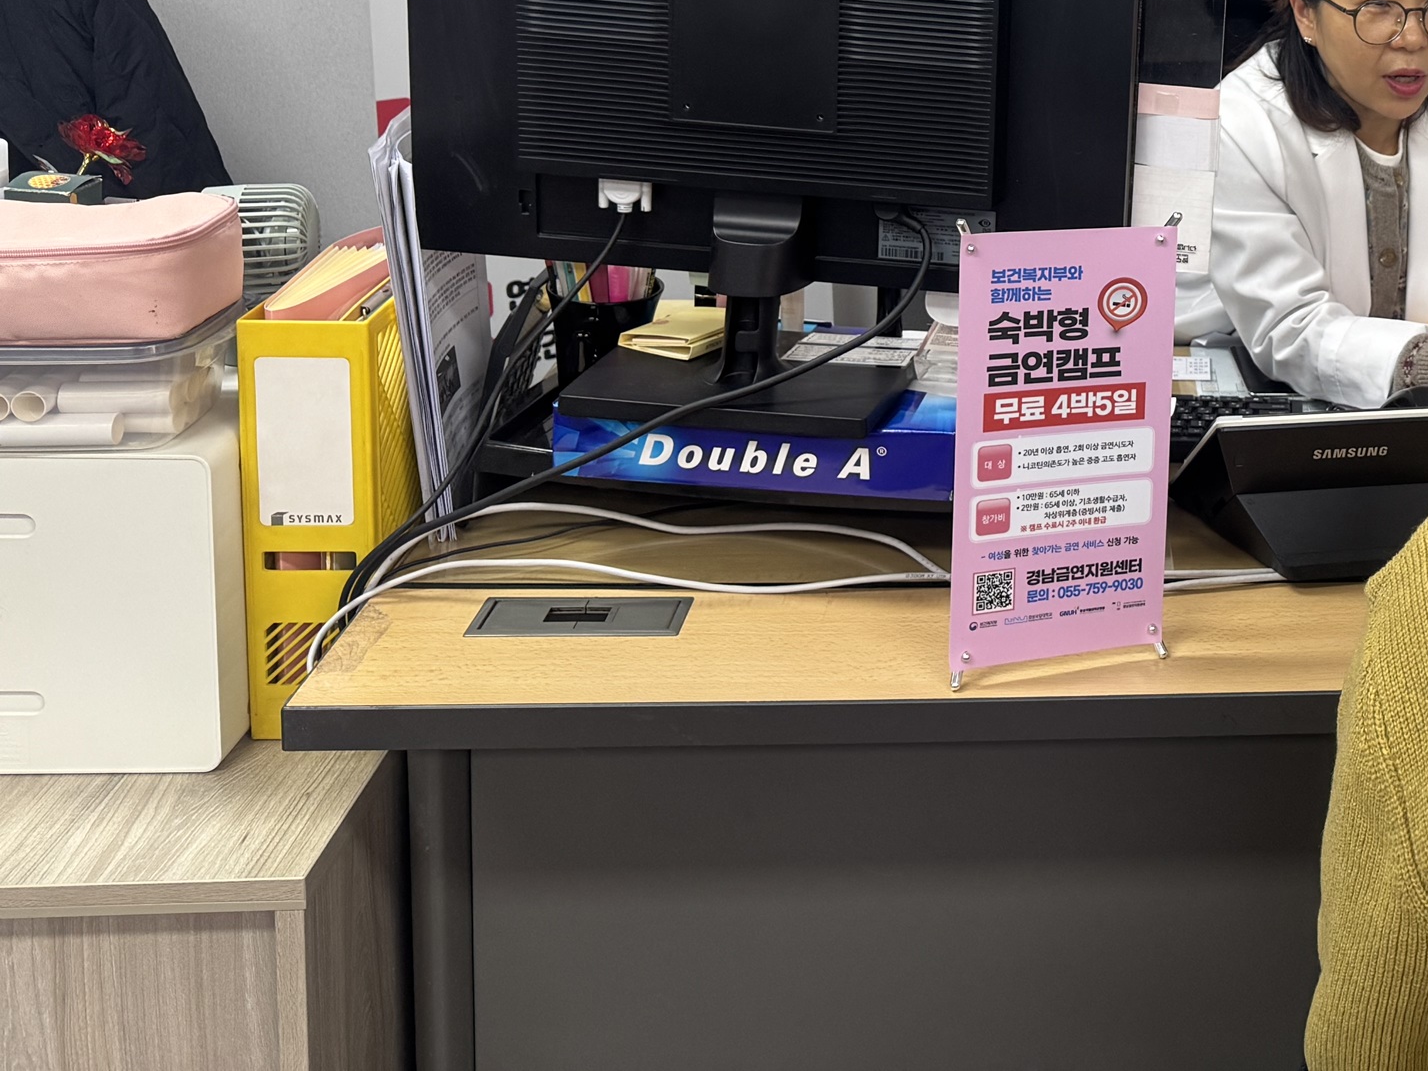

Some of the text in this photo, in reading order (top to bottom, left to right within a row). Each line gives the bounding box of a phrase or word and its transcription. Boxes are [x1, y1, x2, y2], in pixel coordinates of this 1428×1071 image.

[991, 265, 1083, 285] 보건복지부와
[990, 286, 1052, 304] 함께하는
[987, 307, 1090, 345] 숙박형
[986, 346, 1122, 388] 금연캠프
[993, 388, 1137, 425] 무료 4박5일
[638, 433, 818, 477] Double
[1023, 447, 1039, 456] 20년
[1040, 446, 1054, 455] 이상
[1073, 443, 1085, 452] 2회
[1085, 442, 1099, 451] 이상
[1100, 440, 1134, 450] 금연시도자
[1312, 445, 1389, 460] SAMSUNG
[1022, 458, 1070, 470] 니코틴의존도가
[1072, 457, 1085, 466] 높은
[1101, 455, 1115, 463] 고도
[1116, 453, 1137, 462] 흡연자
[1022, 492, 1044, 501] 10만원
[1049, 489, 1065, 498] 65세
[1066, 488, 1080, 497] 이하
[1021, 502, 1040, 512] 2만원
[1044, 500, 1060, 509] 65세
[289, 513, 343, 524] SYSMAX
[982, 513, 1006, 525] 참가비
[1028, 523, 1042, 532] 캠프
[1078, 517, 1092, 526] 이내
[1093, 516, 1107, 524] 환급
[988, 536, 1139, 561] 여성을 위한 찾아가는 금연 서비스 신청 가능
[1026, 558, 1142, 586] 경남금연지원센터
[1027, 588, 1049, 603] 문의
[1057, 577, 1144, 599] 055-759-9030
